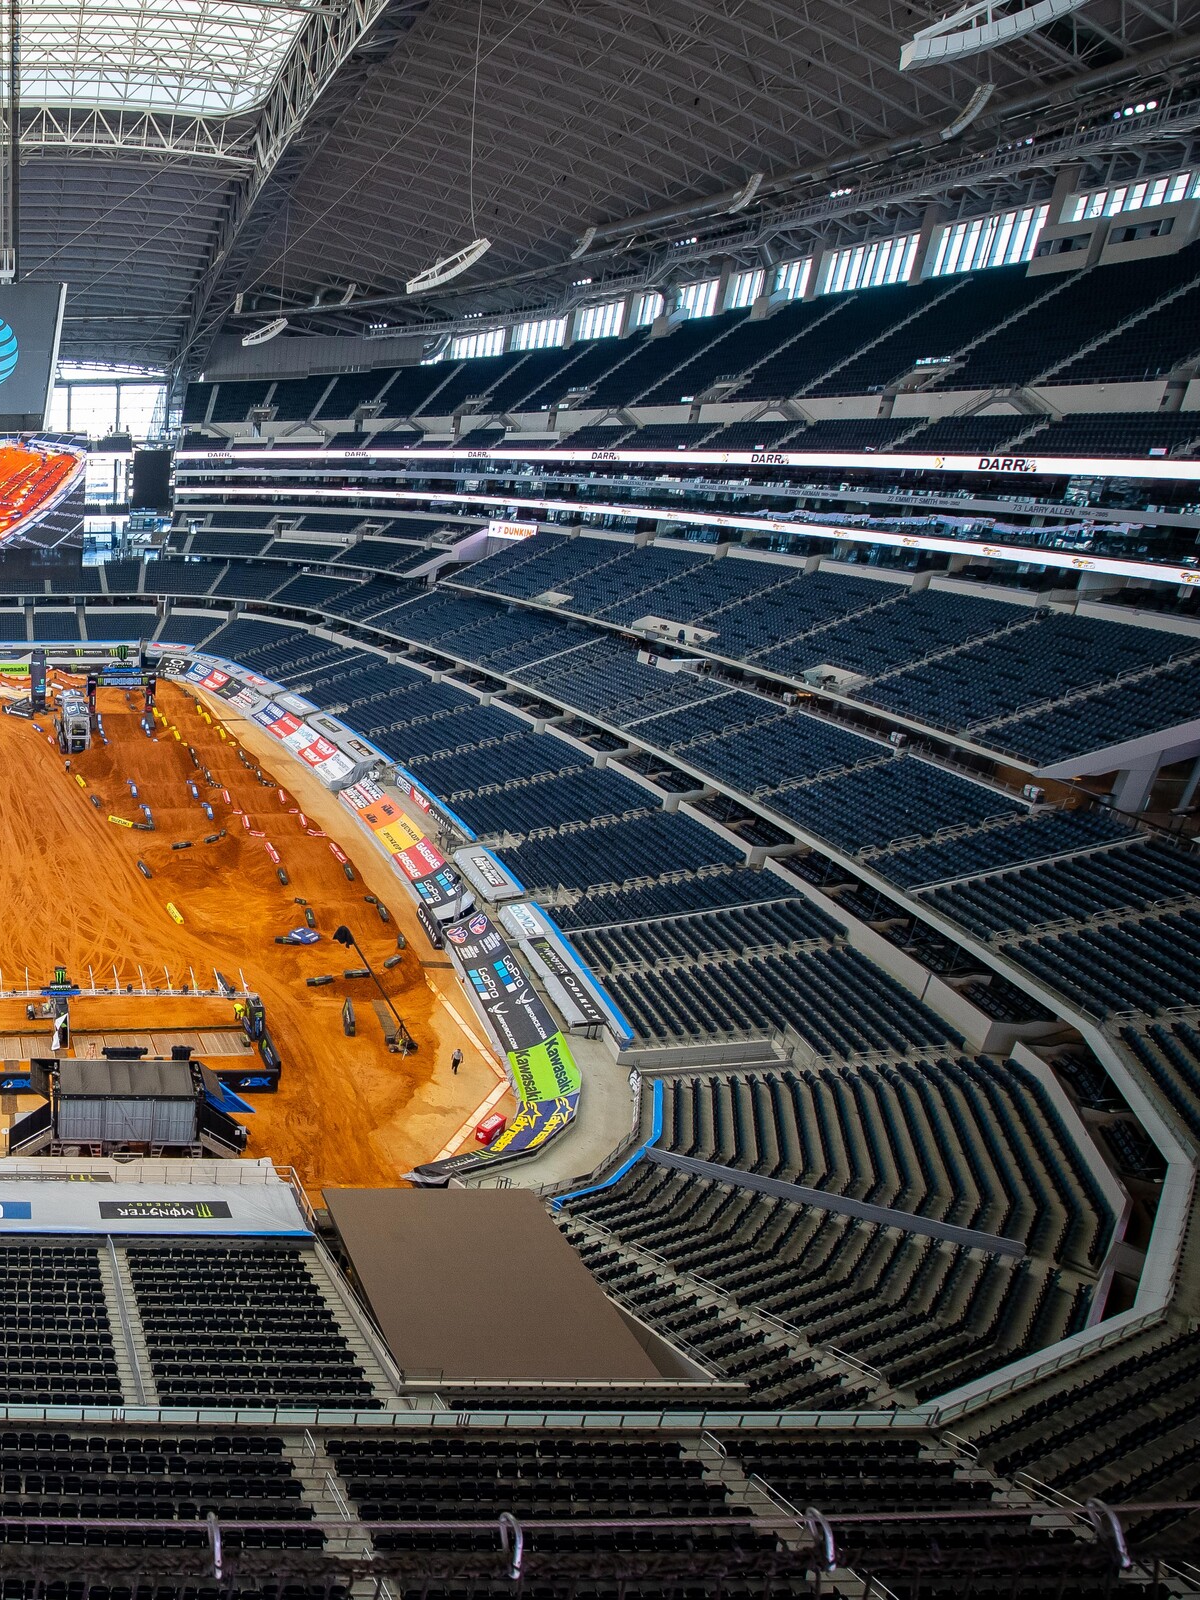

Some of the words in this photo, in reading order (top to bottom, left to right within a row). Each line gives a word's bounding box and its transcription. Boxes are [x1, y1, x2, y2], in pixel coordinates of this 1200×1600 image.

[1013, 504, 1023, 512] 73
[1024, 505, 1048, 514] LARRY
[1049, 507, 1076, 517] ALLEN
[504, 527, 535, 537] DUNKIN'
[364, 813, 378, 824] KTM
[381, 804, 394, 817] KTM
[383, 831, 402, 851] DUNLOP
[401, 822, 420, 842] DUNLOP
[397, 852, 421, 878] GASGAS
[416, 842, 440, 869] GASGAS
[424, 880, 441, 901] GoPro
[502, 954, 524, 987] GoPro
[478, 967, 499, 998] GoPro
[496, 1014, 519, 1049] AIRFORCE.COM
[524, 1004, 547, 1040] AIRFORCE.COM
[514, 1050, 543, 1101] Kawasaki
[545, 1037, 573, 1093] Kawasaki
[117, 1207, 195, 1217] MONSTER
